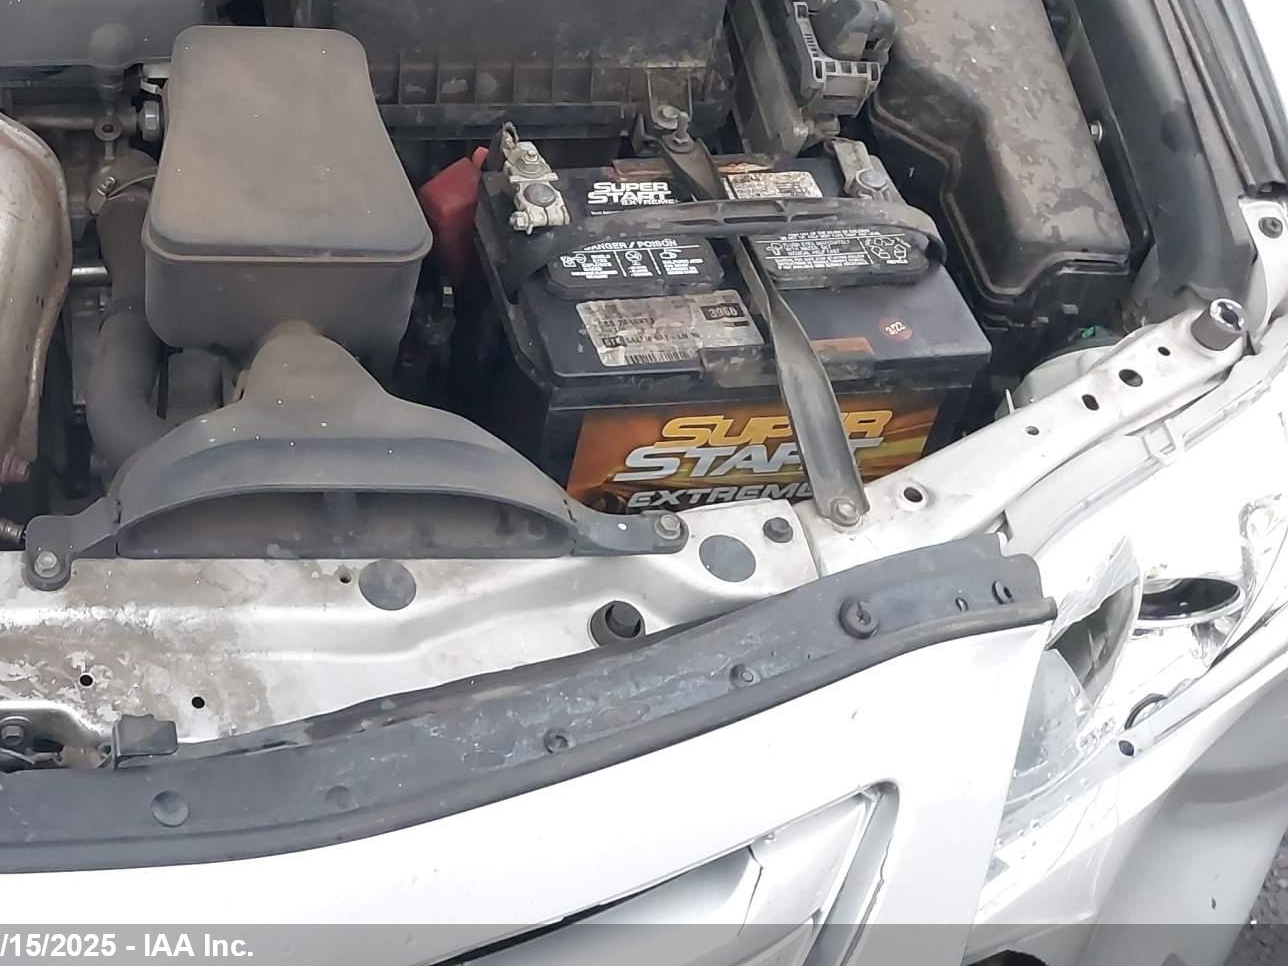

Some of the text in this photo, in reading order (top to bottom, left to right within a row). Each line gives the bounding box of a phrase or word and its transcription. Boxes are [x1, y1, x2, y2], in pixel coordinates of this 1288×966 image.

[593, 181, 669, 193] SUPER
[587, 190, 672, 204] START
[636, 238, 678, 249] POISON
[653, 410, 892, 448] SUPR
